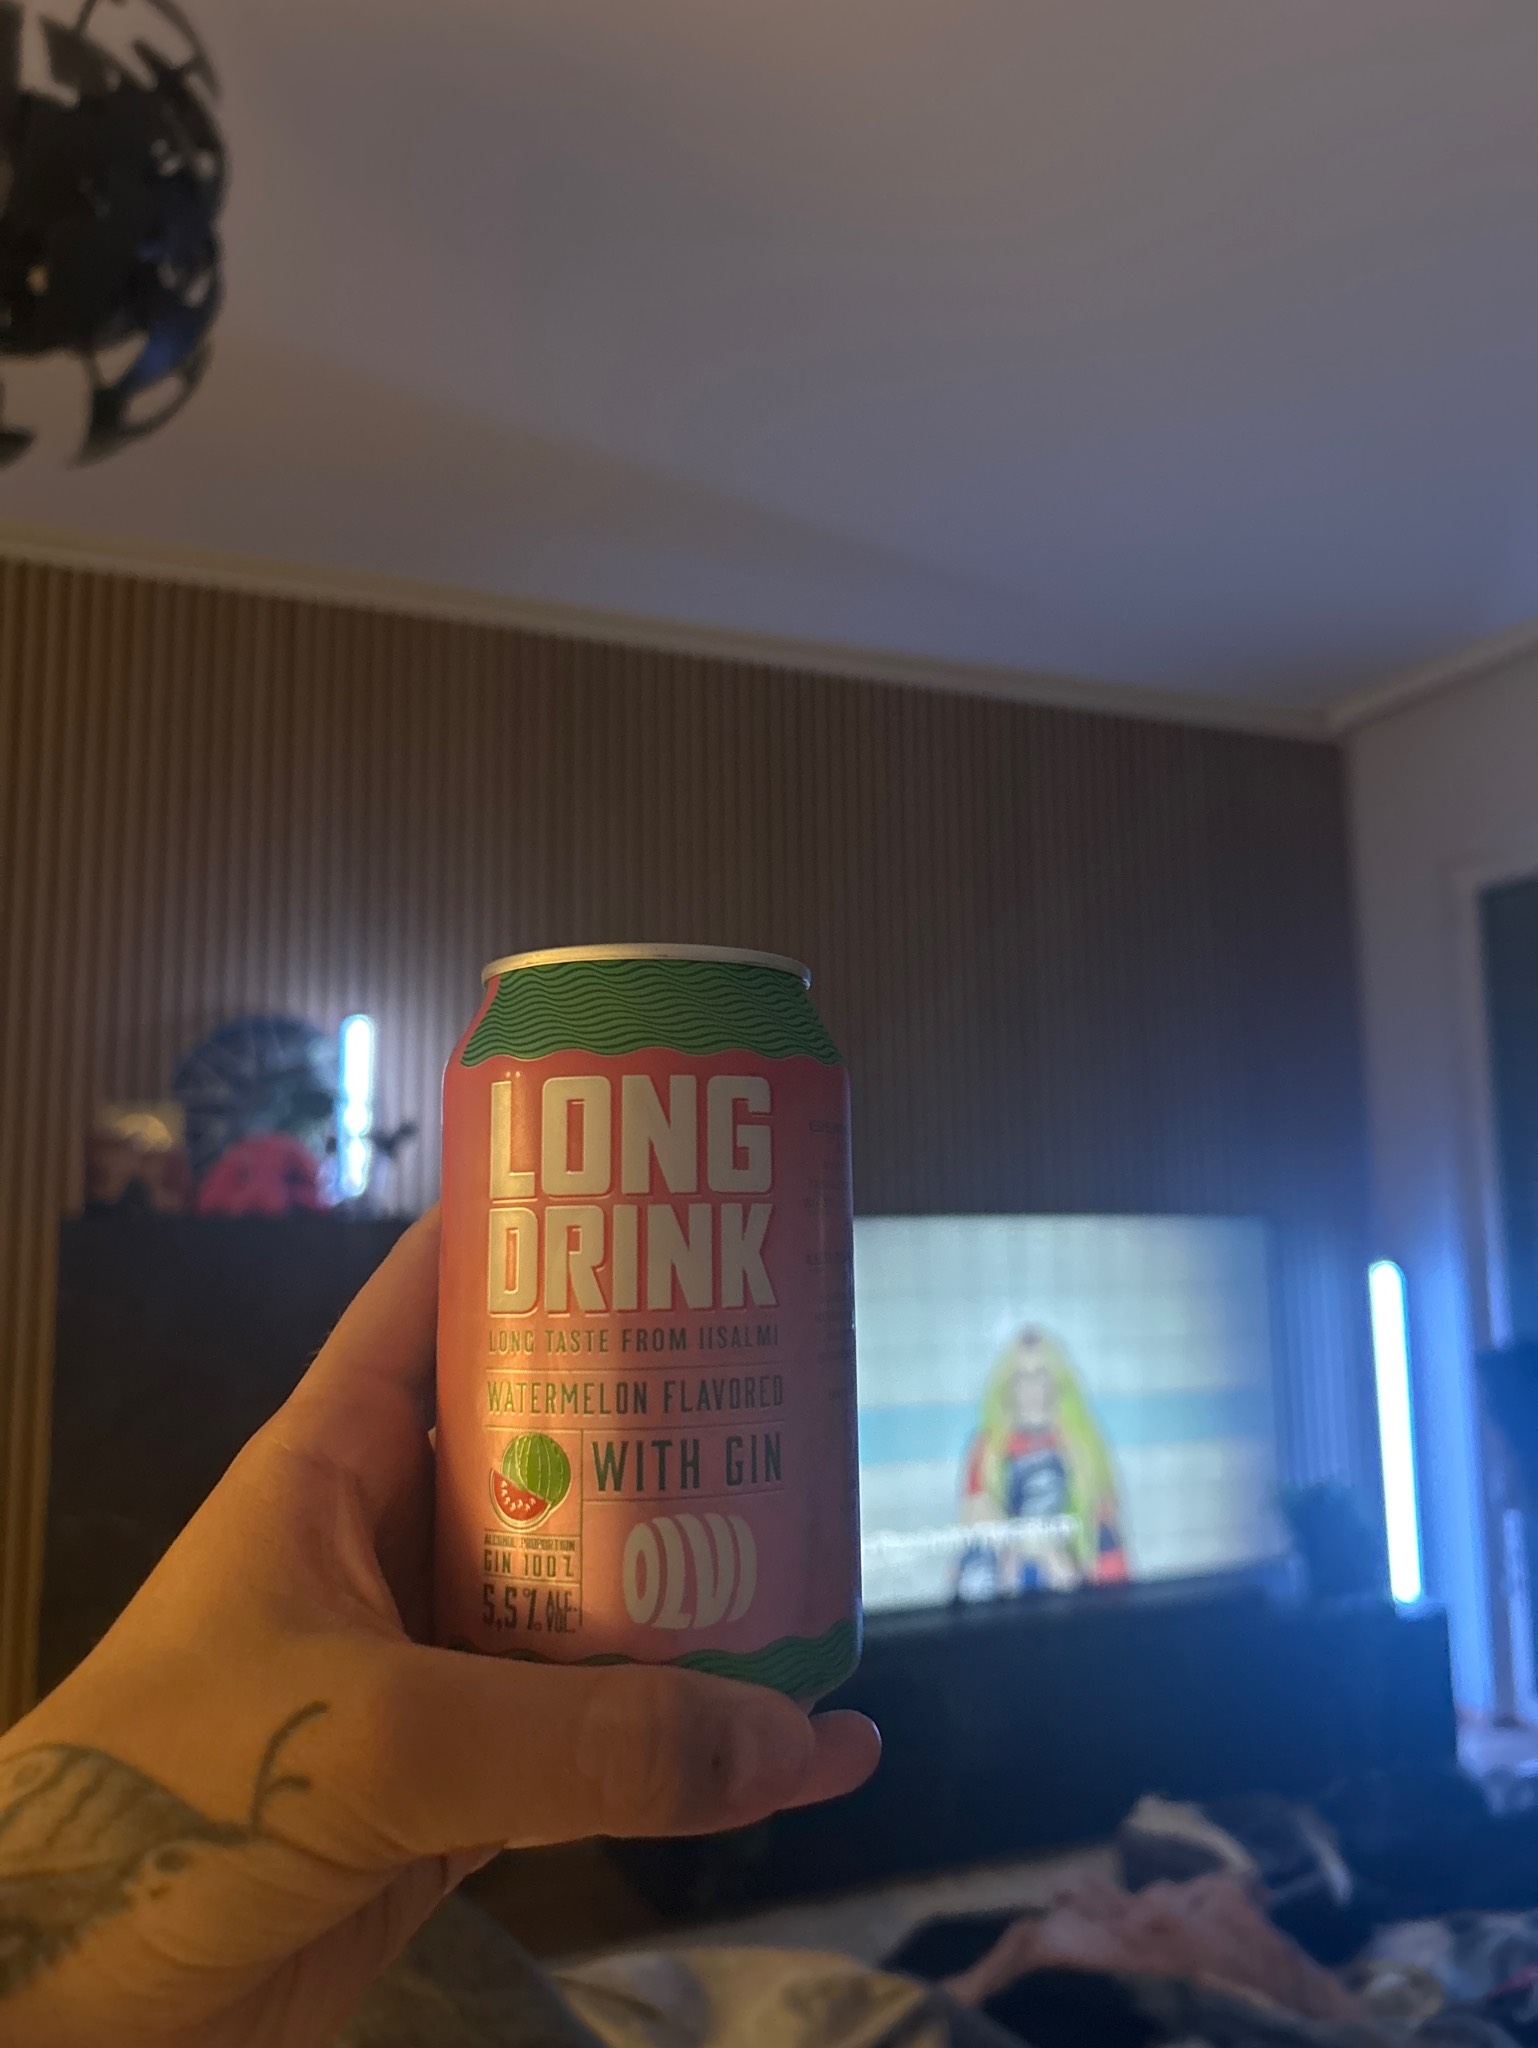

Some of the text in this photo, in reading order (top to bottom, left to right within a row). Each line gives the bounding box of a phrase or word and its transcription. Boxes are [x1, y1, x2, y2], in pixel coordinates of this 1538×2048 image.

[490, 1074, 776, 1198] LONG
[488, 1202, 778, 1314] DRINK
[488, 1325, 779, 1354] LONG TASTE FROM IISALMI
[487, 1380, 648, 1415] WATERMELON
[664, 1375, 784, 1413] FLAVORED
[592, 1431, 782, 1492] WITH GIN
[483, 1549, 511, 1573] GIN
[623, 1513, 757, 1630] OLVI
[482, 1583, 543, 1632] 5,5%
